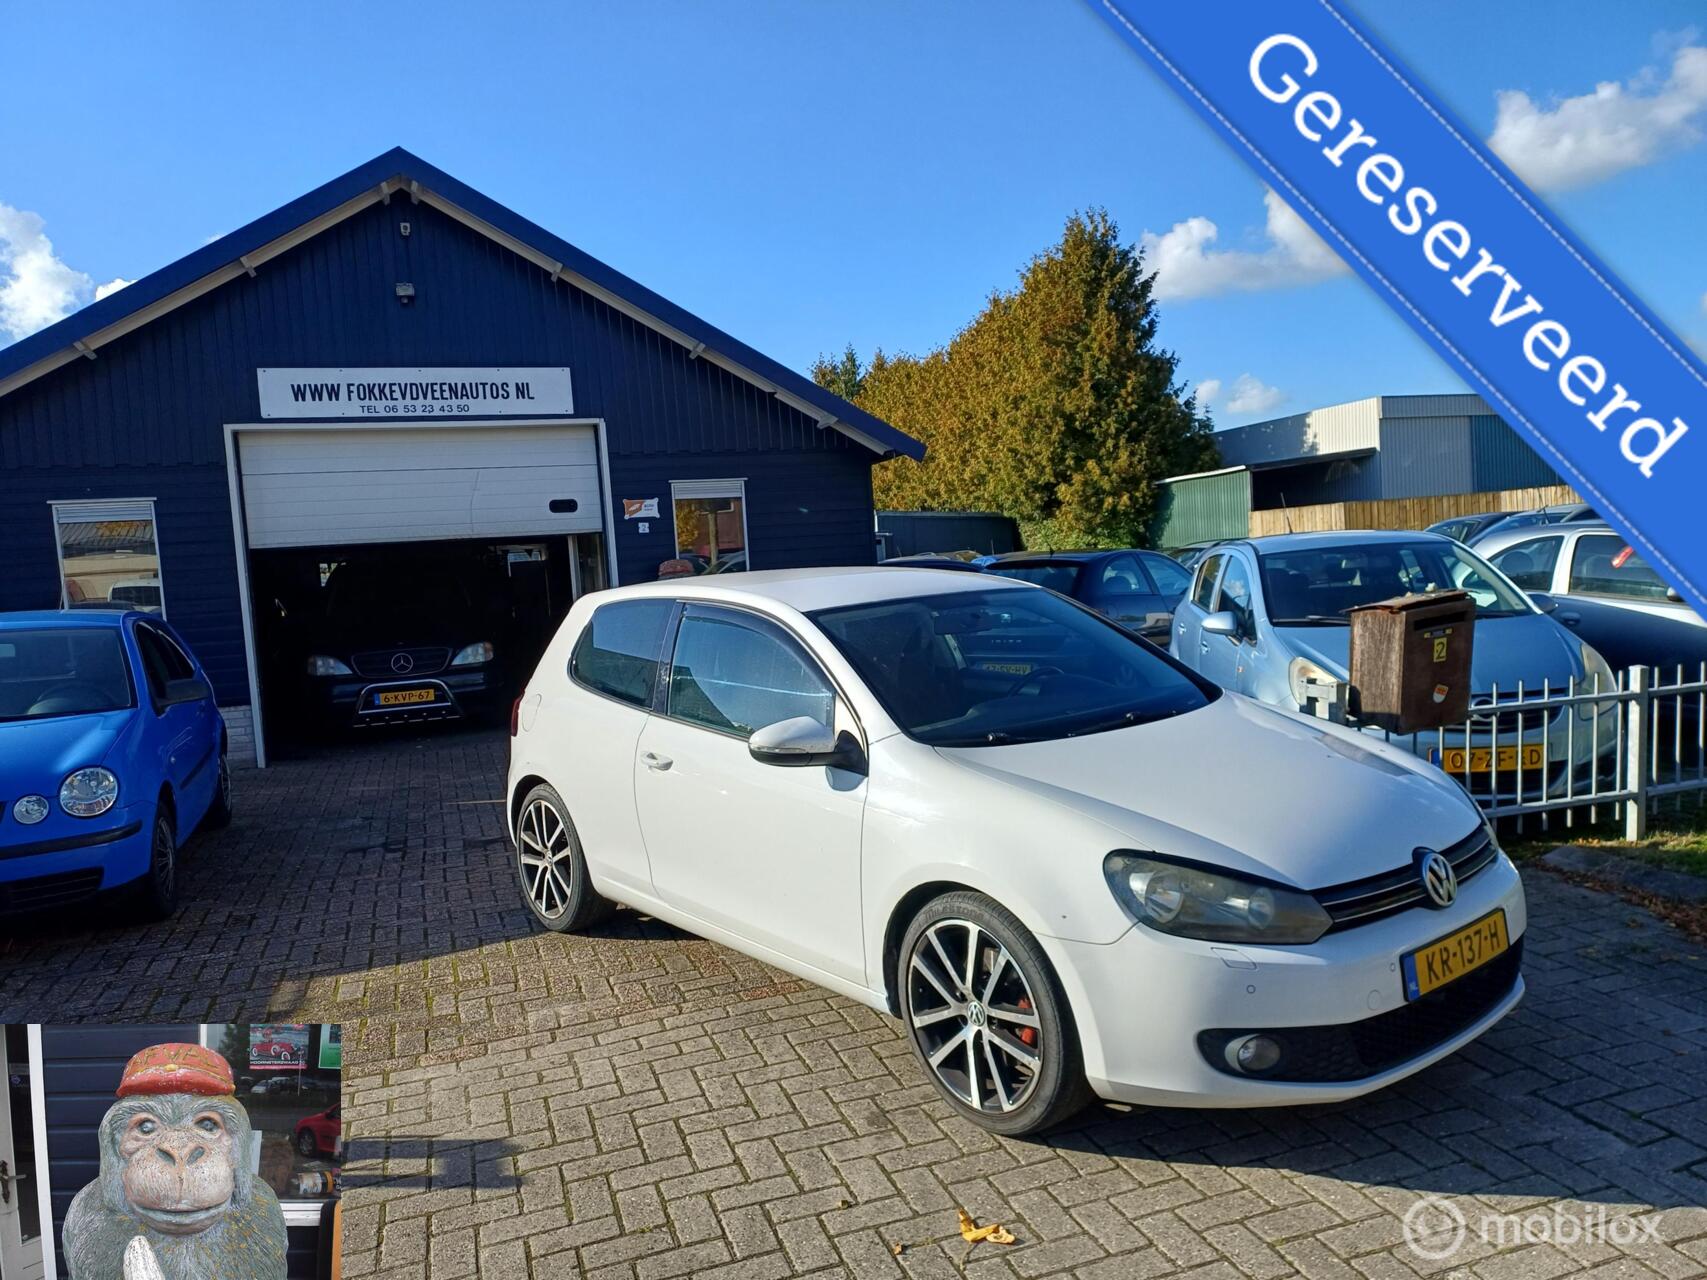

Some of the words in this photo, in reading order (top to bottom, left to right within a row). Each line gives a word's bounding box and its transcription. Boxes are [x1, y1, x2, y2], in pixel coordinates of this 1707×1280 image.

[359, 404, 381, 414] TEL
[384, 404, 399, 414] 06
[403, 404, 419, 414] 53
[421, 403, 435, 414] 23
[438, 403, 454, 413] 43
[456, 403, 470, 413] 50
[1436, 641, 1446, 660] 2
[384, 691, 430, 703] 6-KVP-67
[1425, 919, 1501, 985] KR-137-H
